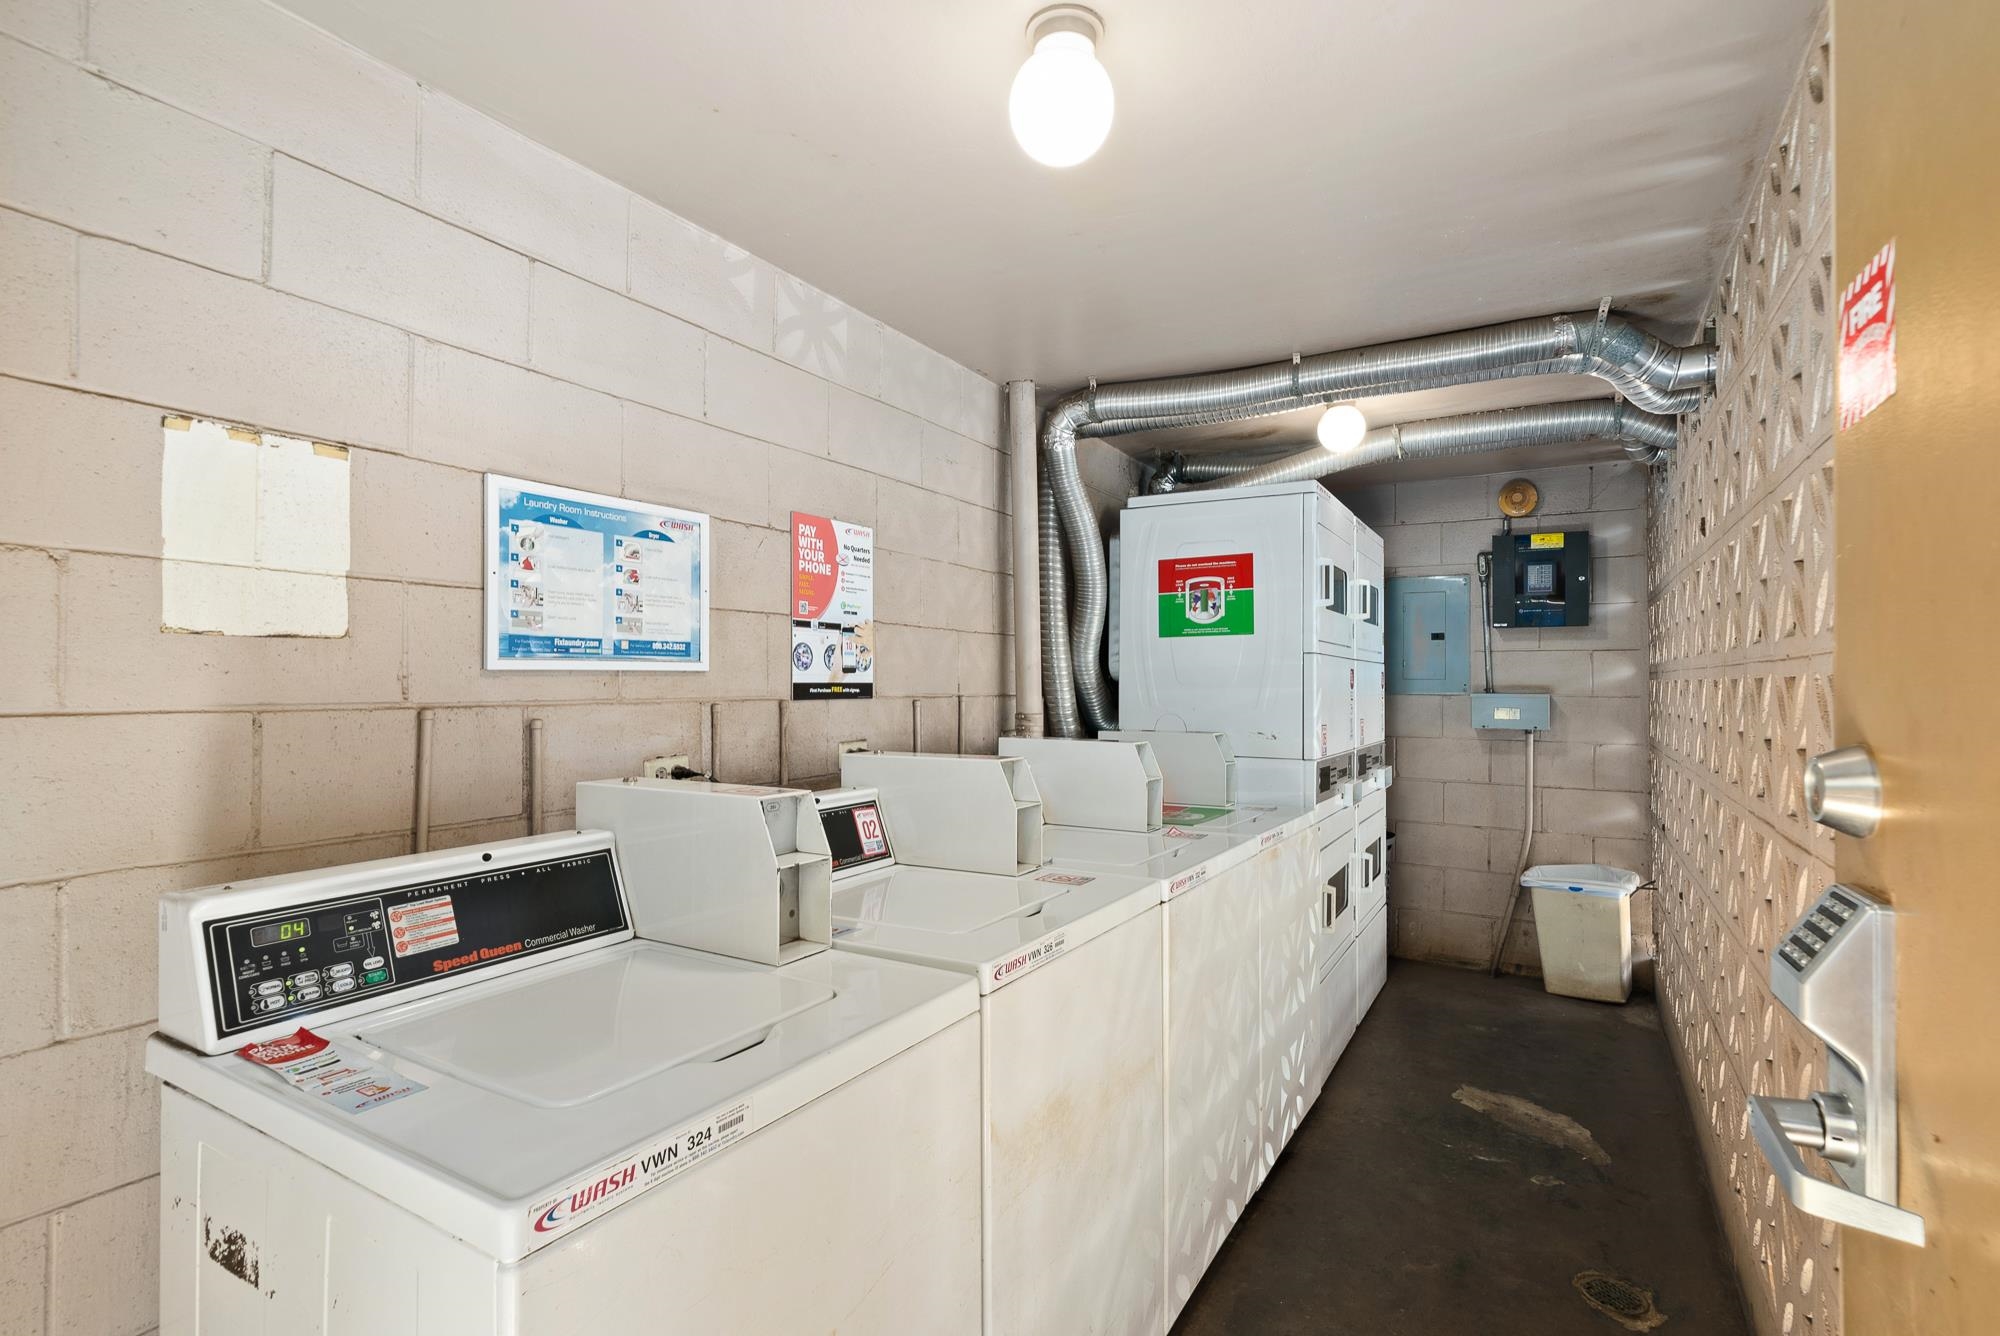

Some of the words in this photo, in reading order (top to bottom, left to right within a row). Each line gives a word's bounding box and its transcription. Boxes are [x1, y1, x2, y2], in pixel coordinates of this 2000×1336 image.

[523, 497, 557, 512] Laundry
[559, 503, 582, 515] Room
[584, 507, 627, 522] Instructions
[671, 522, 694, 532] WASH
[798, 523, 817, 538] PAY
[798, 536, 823, 551] WITH
[851, 546, 870, 554] Quarters
[798, 548, 825, 562] YOUR
[854, 556, 870, 564] Needed
[799, 560, 832, 576] PHONE
[554, 638, 599, 648] Fixlaundry.com
[862, 820, 879, 840] 02
[407, 882, 469, 897] PERMANENT
[481, 873, 511, 884] PRESS
[562, 859, 592, 868] FABRIC
[280, 922, 304, 939] 04
[433, 948, 479, 973] Speed
[480, 941, 523, 961] Queen
[525, 929, 569, 949] Commercial
[569, 923, 596, 937] Washer
[1005, 954, 1027, 974] WASH
[1028, 948, 1042, 960] VWN
[570, 1164, 636, 1213] WASH
[641, 1143, 678, 1174] VWN
[687, 1126, 712, 1151] 324
